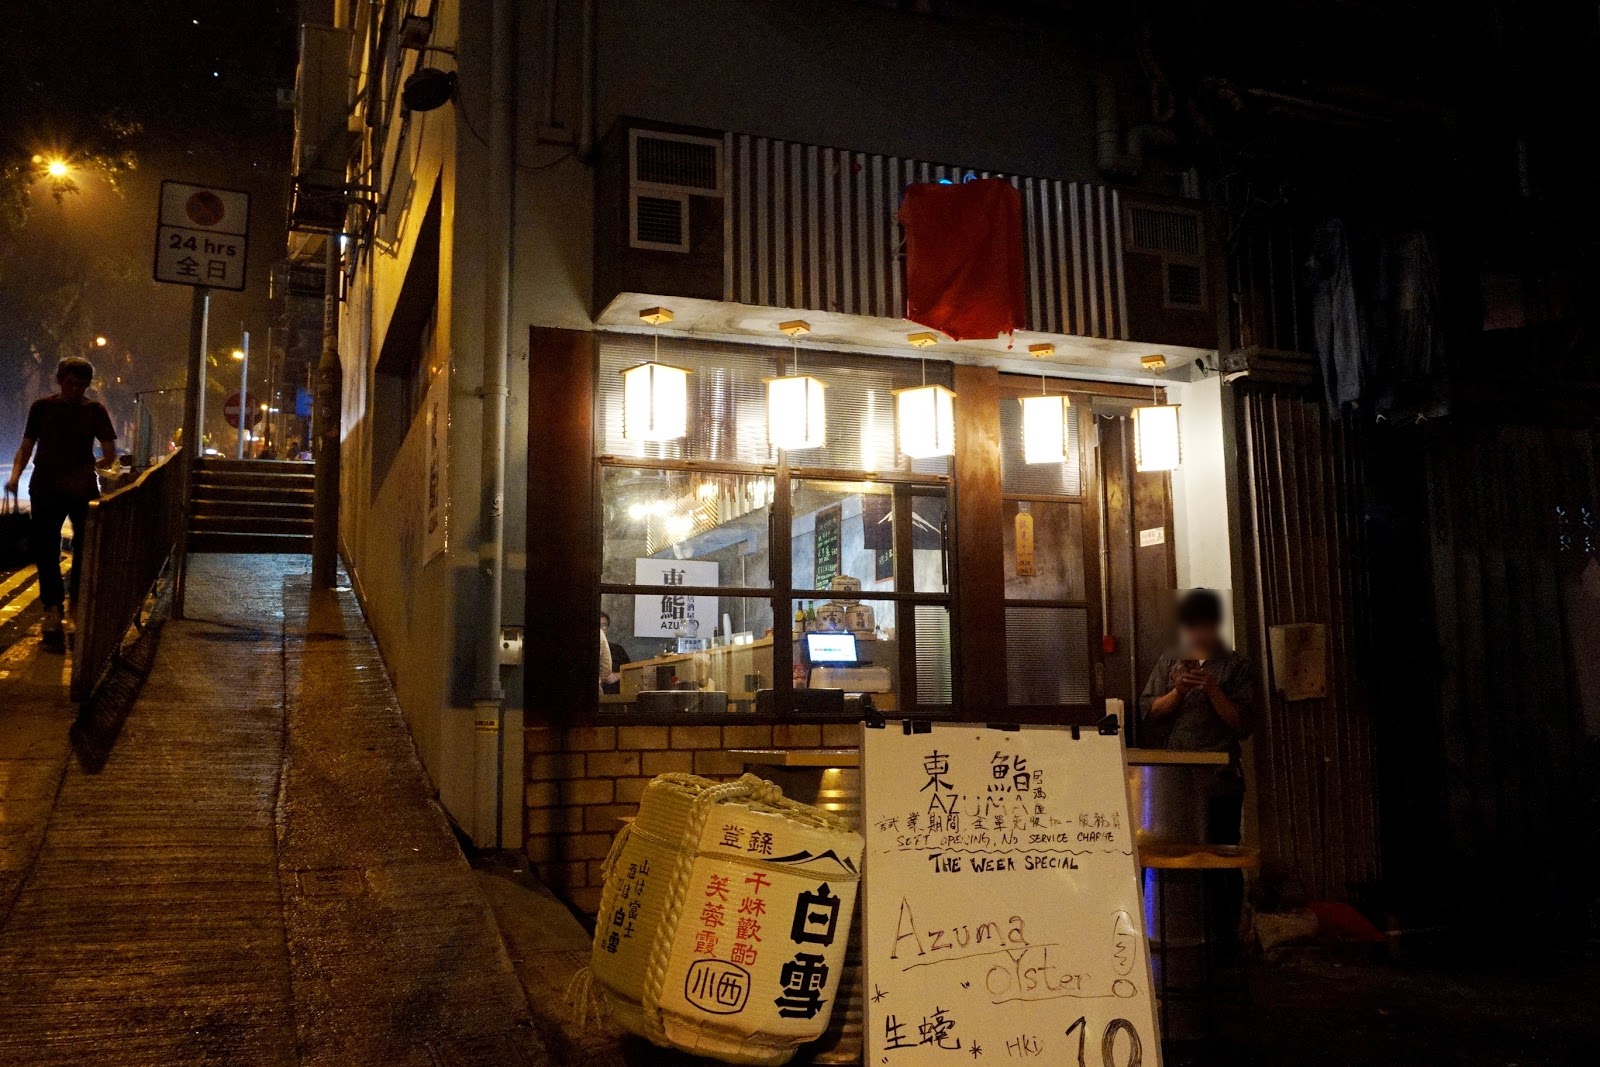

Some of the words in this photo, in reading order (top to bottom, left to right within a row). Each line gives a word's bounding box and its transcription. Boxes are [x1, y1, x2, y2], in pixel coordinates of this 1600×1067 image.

[169, 233, 197, 251] 24
[204, 239, 236, 257] hrs
[176, 256, 226, 280] 全日
[1028, 832, 1069, 844] SERVICE
[1076, 831, 1114, 843] CHARGE
[928, 853, 962, 874] THE
[970, 855, 1015, 873] WEEK
[1024, 853, 1079, 870] SPECIAL
[890, 896, 1030, 959] Azuma
[773, 881, 842, 1020] 白雪
